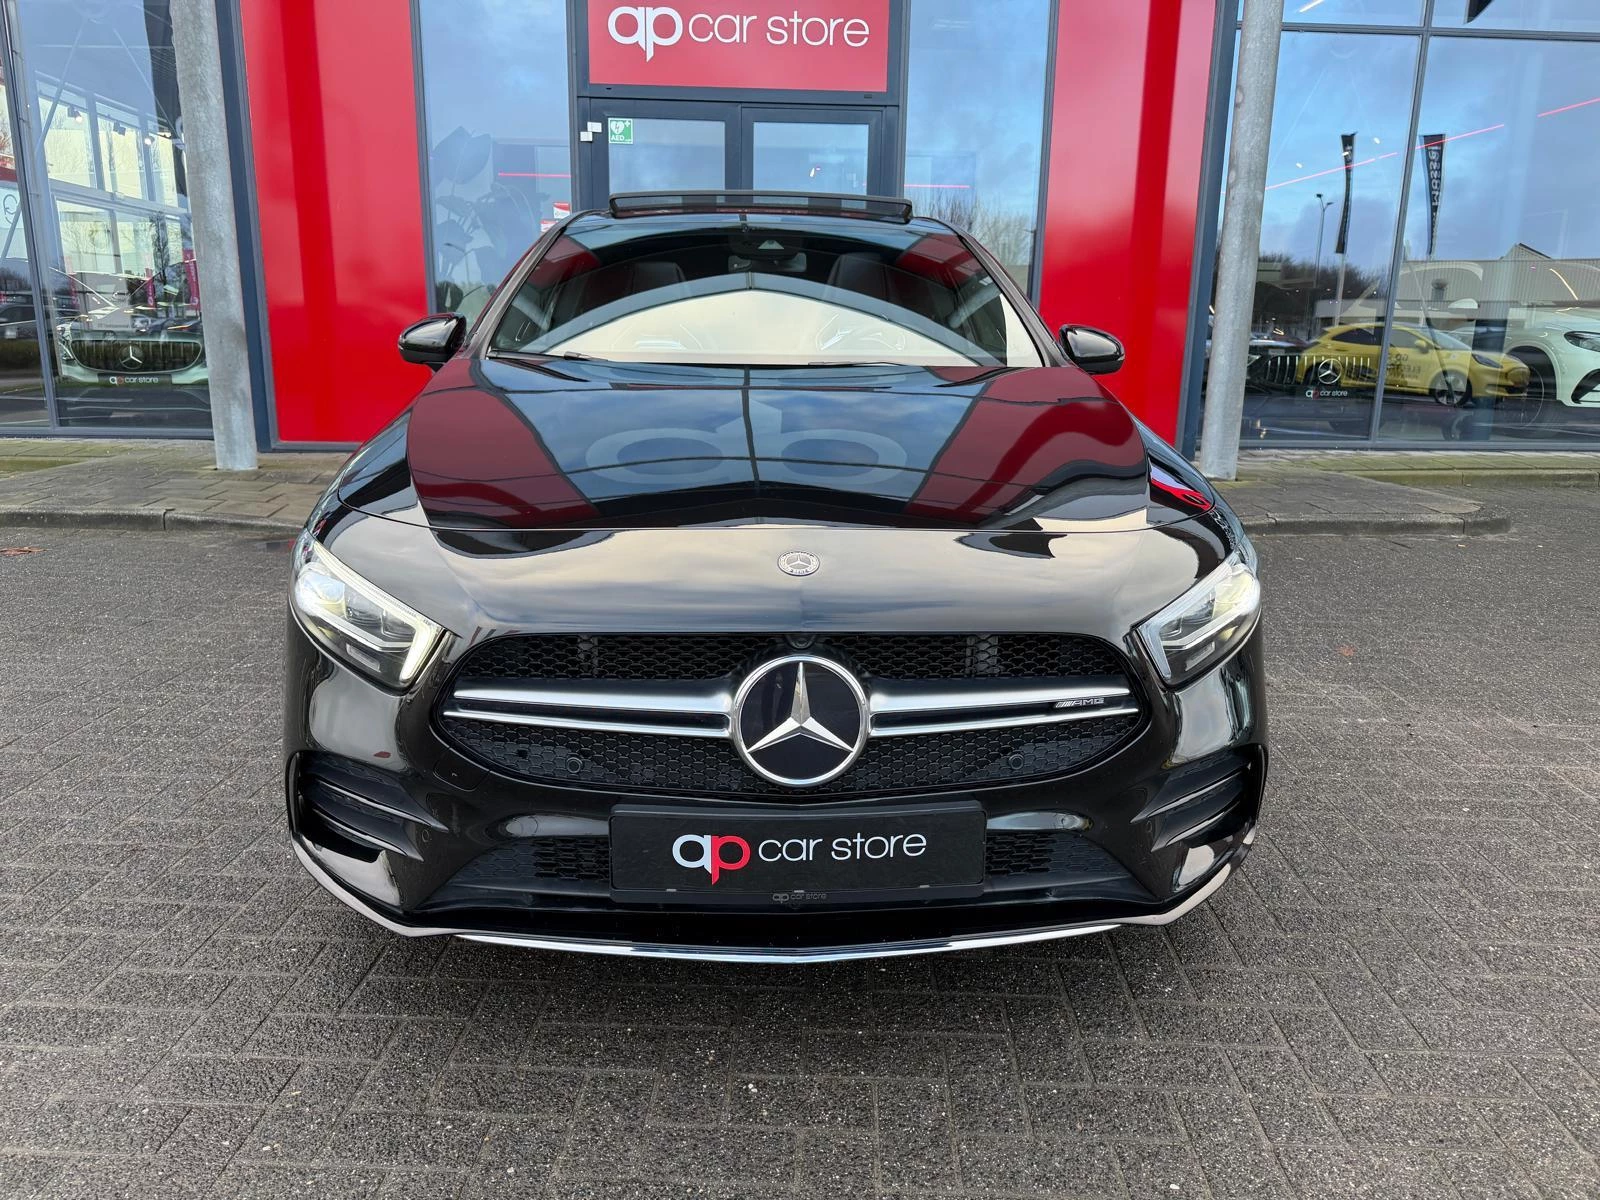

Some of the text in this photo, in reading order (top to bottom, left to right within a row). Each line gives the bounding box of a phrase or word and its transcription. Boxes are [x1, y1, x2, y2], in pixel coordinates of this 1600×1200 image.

[689, 14, 757, 43] car
[767, 11, 869, 47] store
[758, 838, 823, 862] car
[831, 832, 927, 861] store
